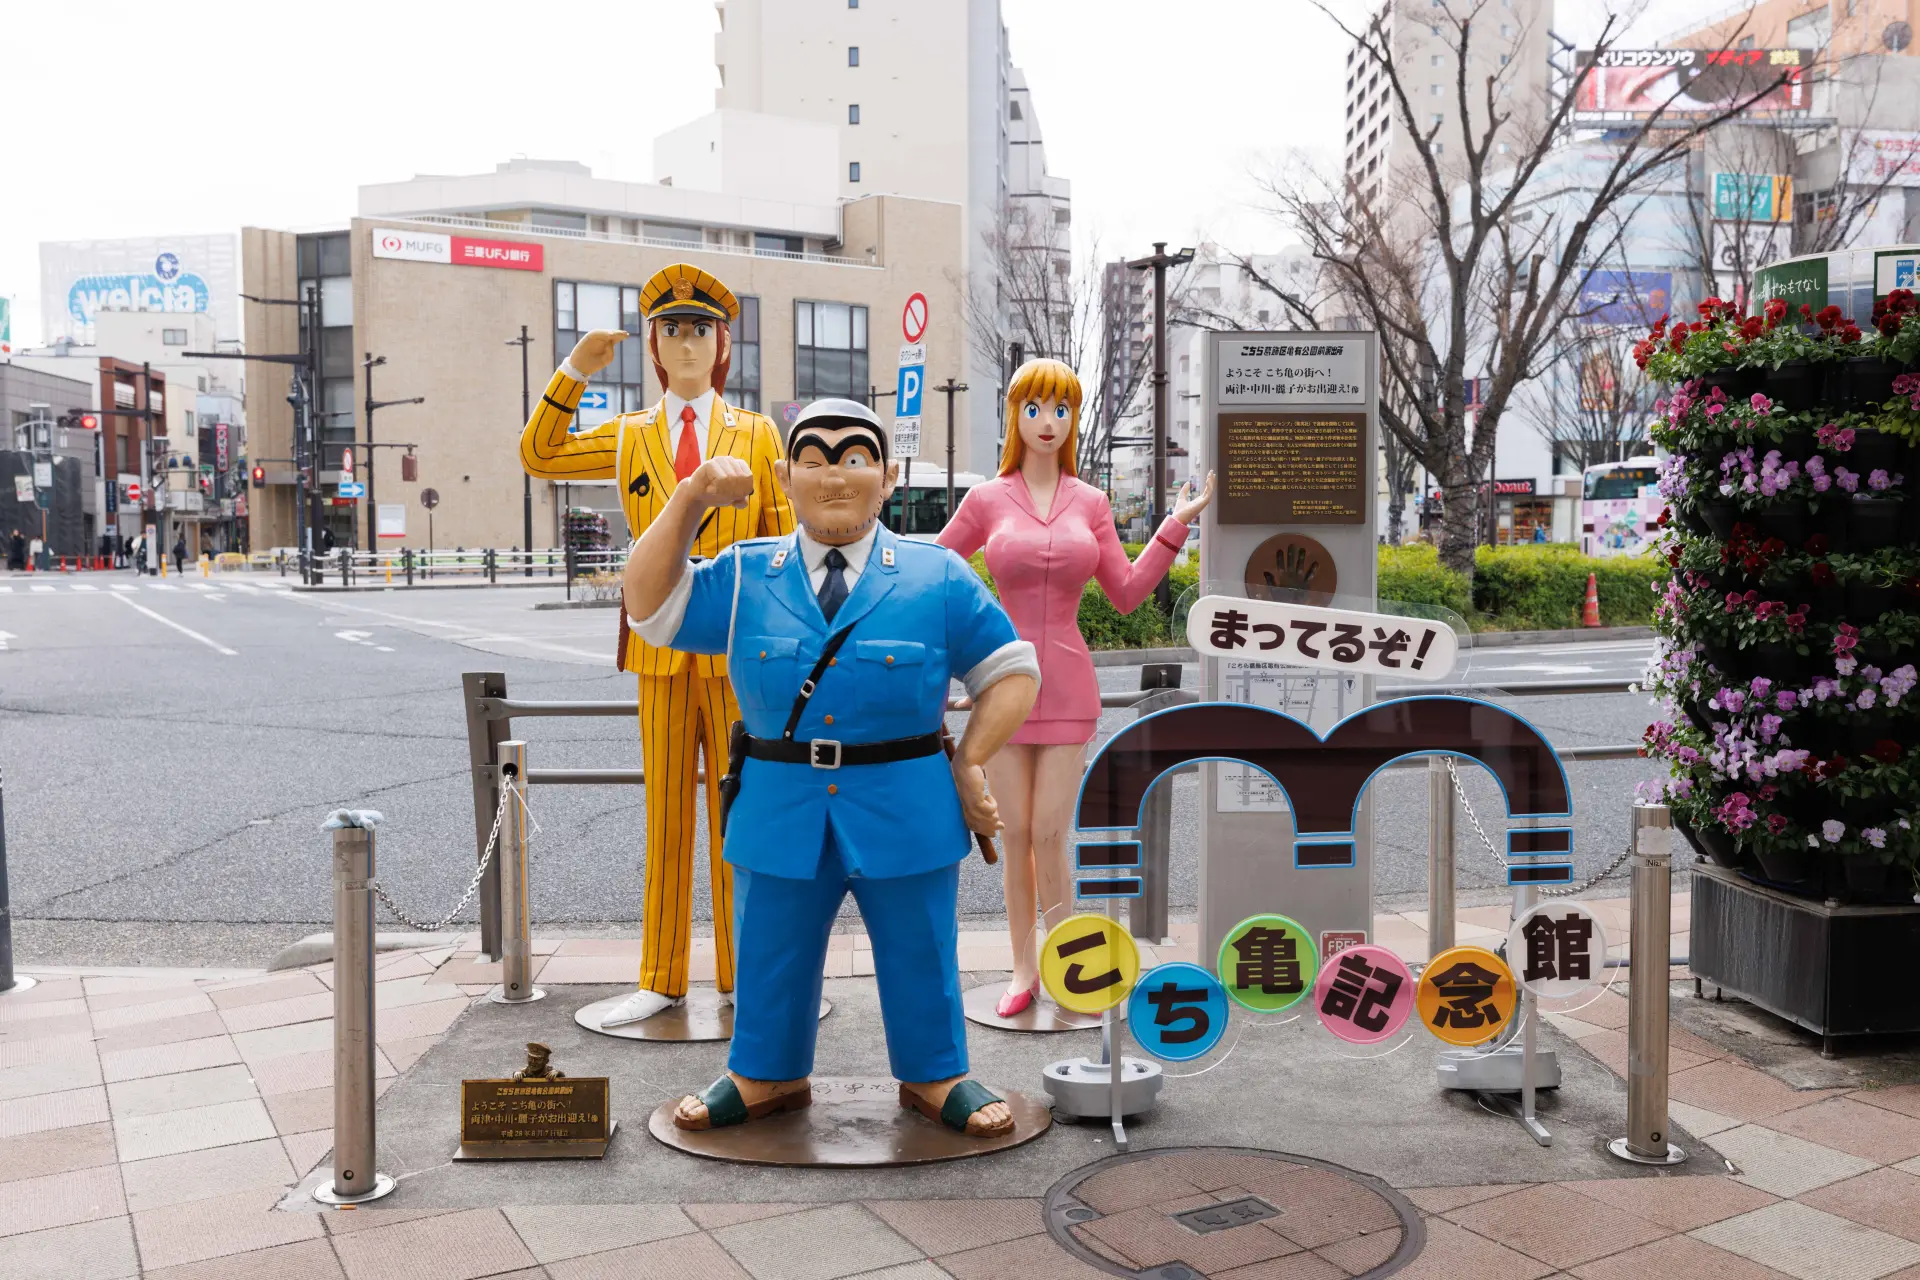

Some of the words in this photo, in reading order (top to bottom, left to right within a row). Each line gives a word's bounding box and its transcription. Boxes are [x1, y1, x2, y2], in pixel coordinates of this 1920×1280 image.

[406, 240, 443, 254] MUFG
[464, 246, 530, 262] 三菱UFJ銀行
[78, 279, 196, 314] welcia
[1226, 368, 1262, 378] ようこそ
[902, 371, 920, 413] P
[1210, 609, 1437, 671] まってるぞ！
[471, 1102, 507, 1111] ようこそ
